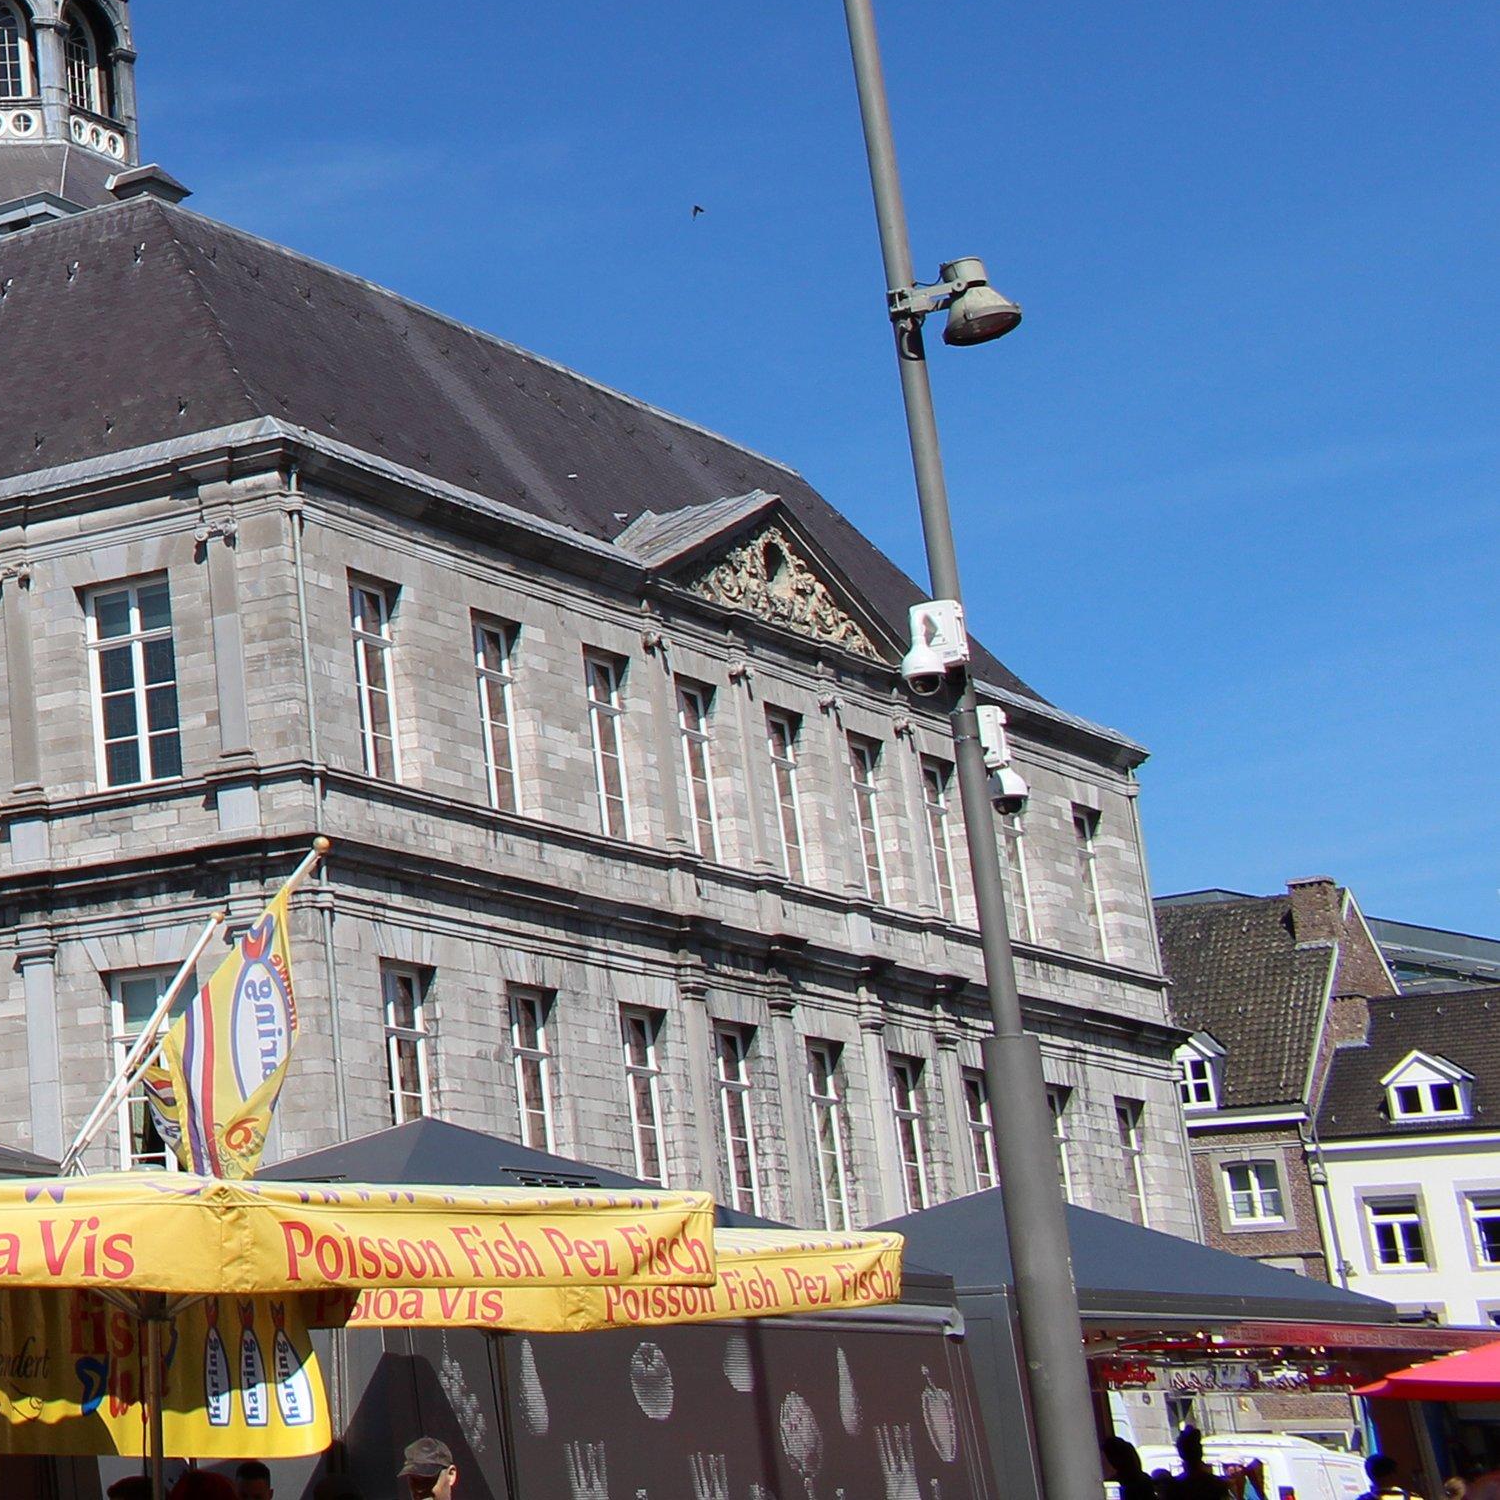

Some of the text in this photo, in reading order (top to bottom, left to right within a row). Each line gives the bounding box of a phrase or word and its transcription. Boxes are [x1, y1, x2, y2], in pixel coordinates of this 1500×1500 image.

[37, 1216, 136, 1280] Vis
[280, 1218, 713, 1282] Poisson Fish Pez Fisch
[438, 1287, 504, 1322] Vis
[604, 1258, 899, 1323] Poisson Fish Pez Fisch
[208, 1338, 221, 1420] haring
[243, 1338, 260, 1420] haring
[277, 1340, 301, 1419] haring
